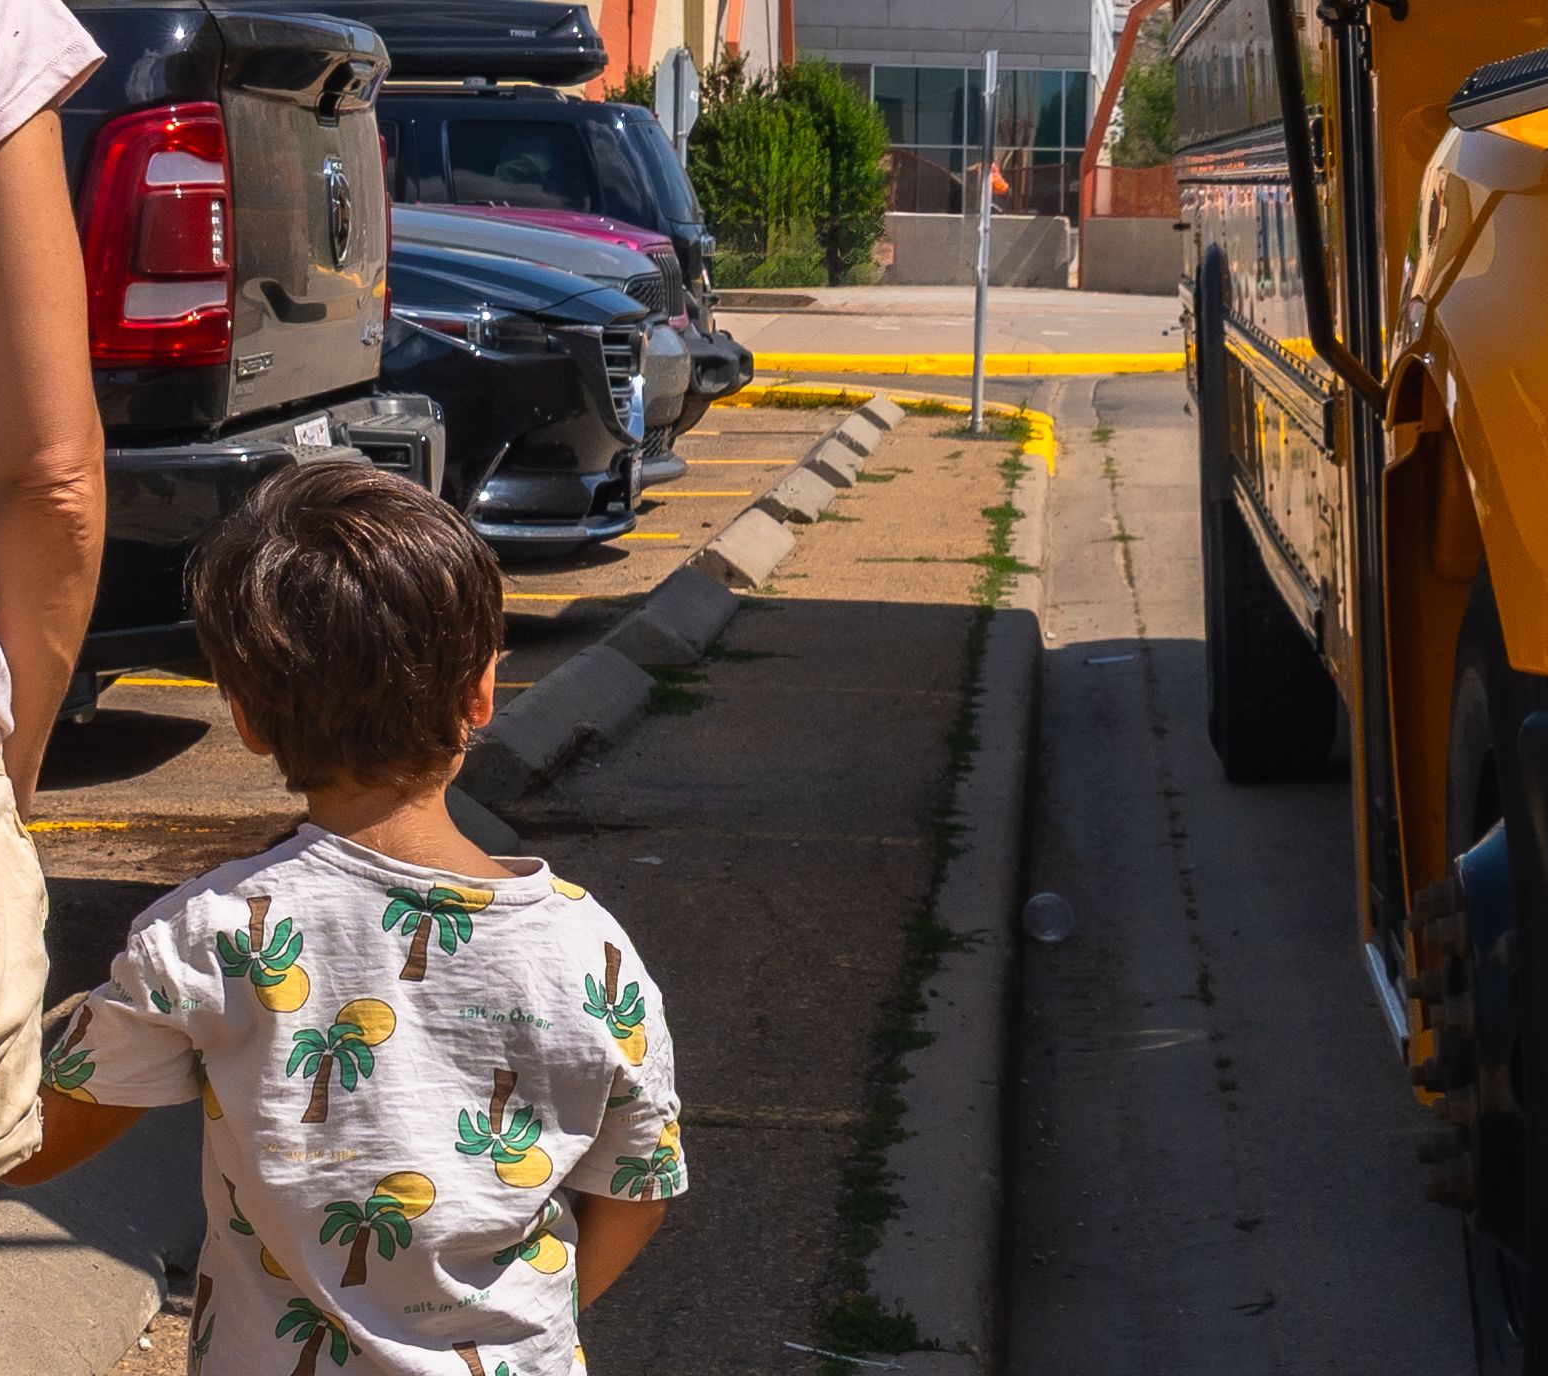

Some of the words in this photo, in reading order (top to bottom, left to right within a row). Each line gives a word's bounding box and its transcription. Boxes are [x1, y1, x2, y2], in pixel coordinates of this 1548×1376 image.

[458, 1007, 488, 1020] salt
[493, 1011, 505, 1023] in
[509, 1007, 534, 1023] the
[535, 1018, 554, 1030] air
[404, 1302, 434, 1314] salt
[439, 1304, 452, 1313] in
[457, 1295, 477, 1308] the
